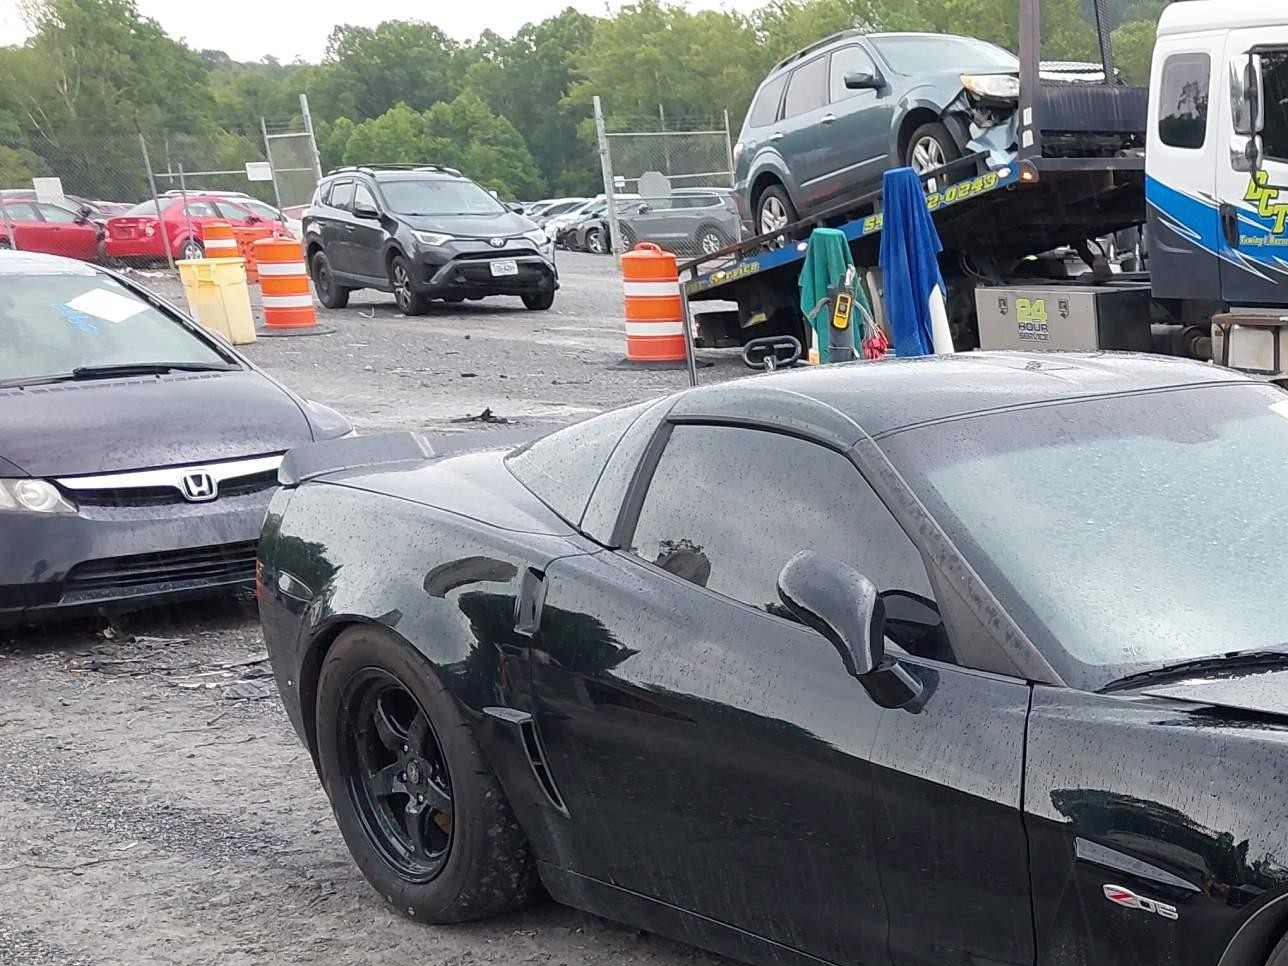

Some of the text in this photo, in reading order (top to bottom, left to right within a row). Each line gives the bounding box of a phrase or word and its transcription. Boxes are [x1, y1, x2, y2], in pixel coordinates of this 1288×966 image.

[711, 262, 759, 283] Srvice
[1015, 298, 1047, 323] 24
[1018, 322, 1048, 332] HOUR
